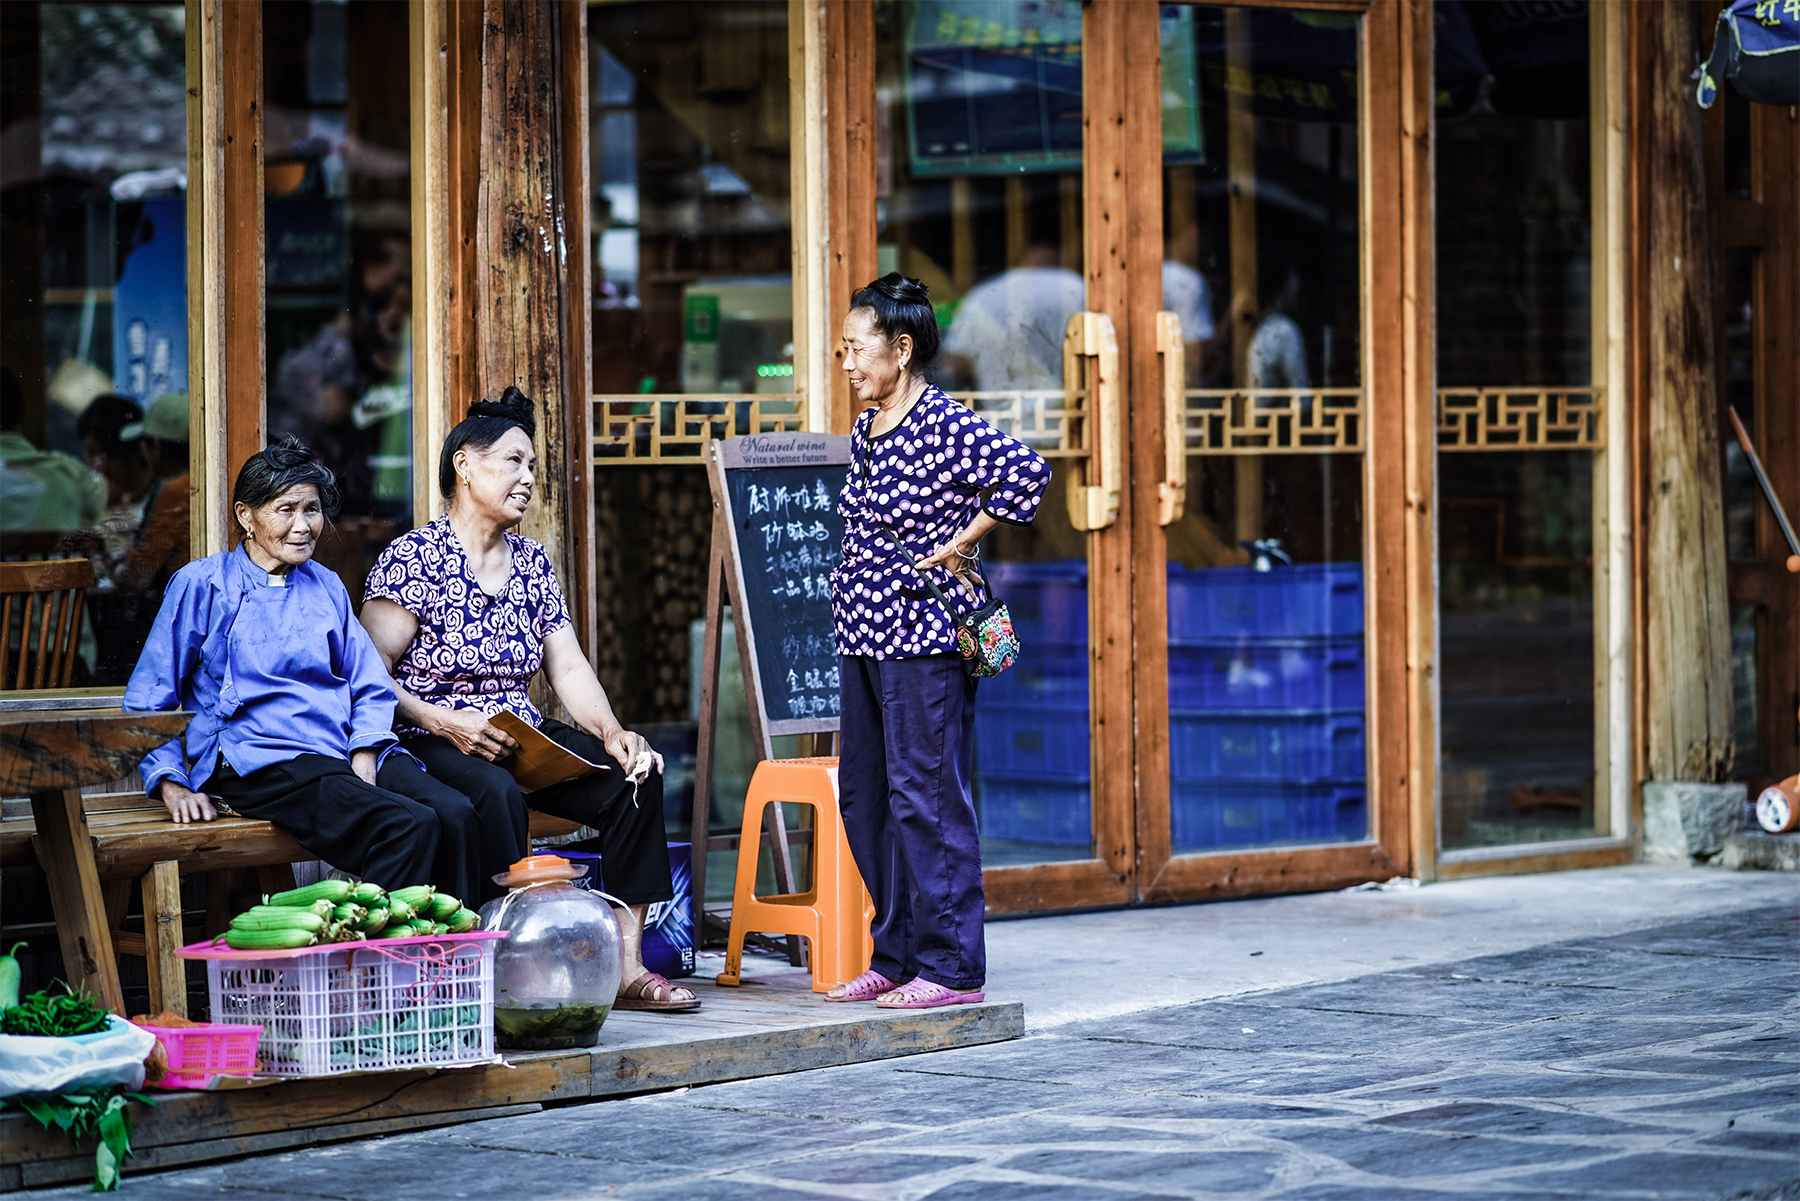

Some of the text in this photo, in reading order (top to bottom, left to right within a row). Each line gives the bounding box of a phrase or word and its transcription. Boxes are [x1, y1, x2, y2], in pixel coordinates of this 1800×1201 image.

[1754, 0, 1800, 27] 红牛
[740, 435, 796, 454] Natural
[743, 455, 768, 464] Write
[775, 454, 800, 464] better
[802, 453, 828, 463] future
[747, 478, 831, 520] 厨师推荐
[772, 573, 832, 601] 一品豆腐
[644, 890, 691, 929] erX
[681, 951, 693, 962] 12
